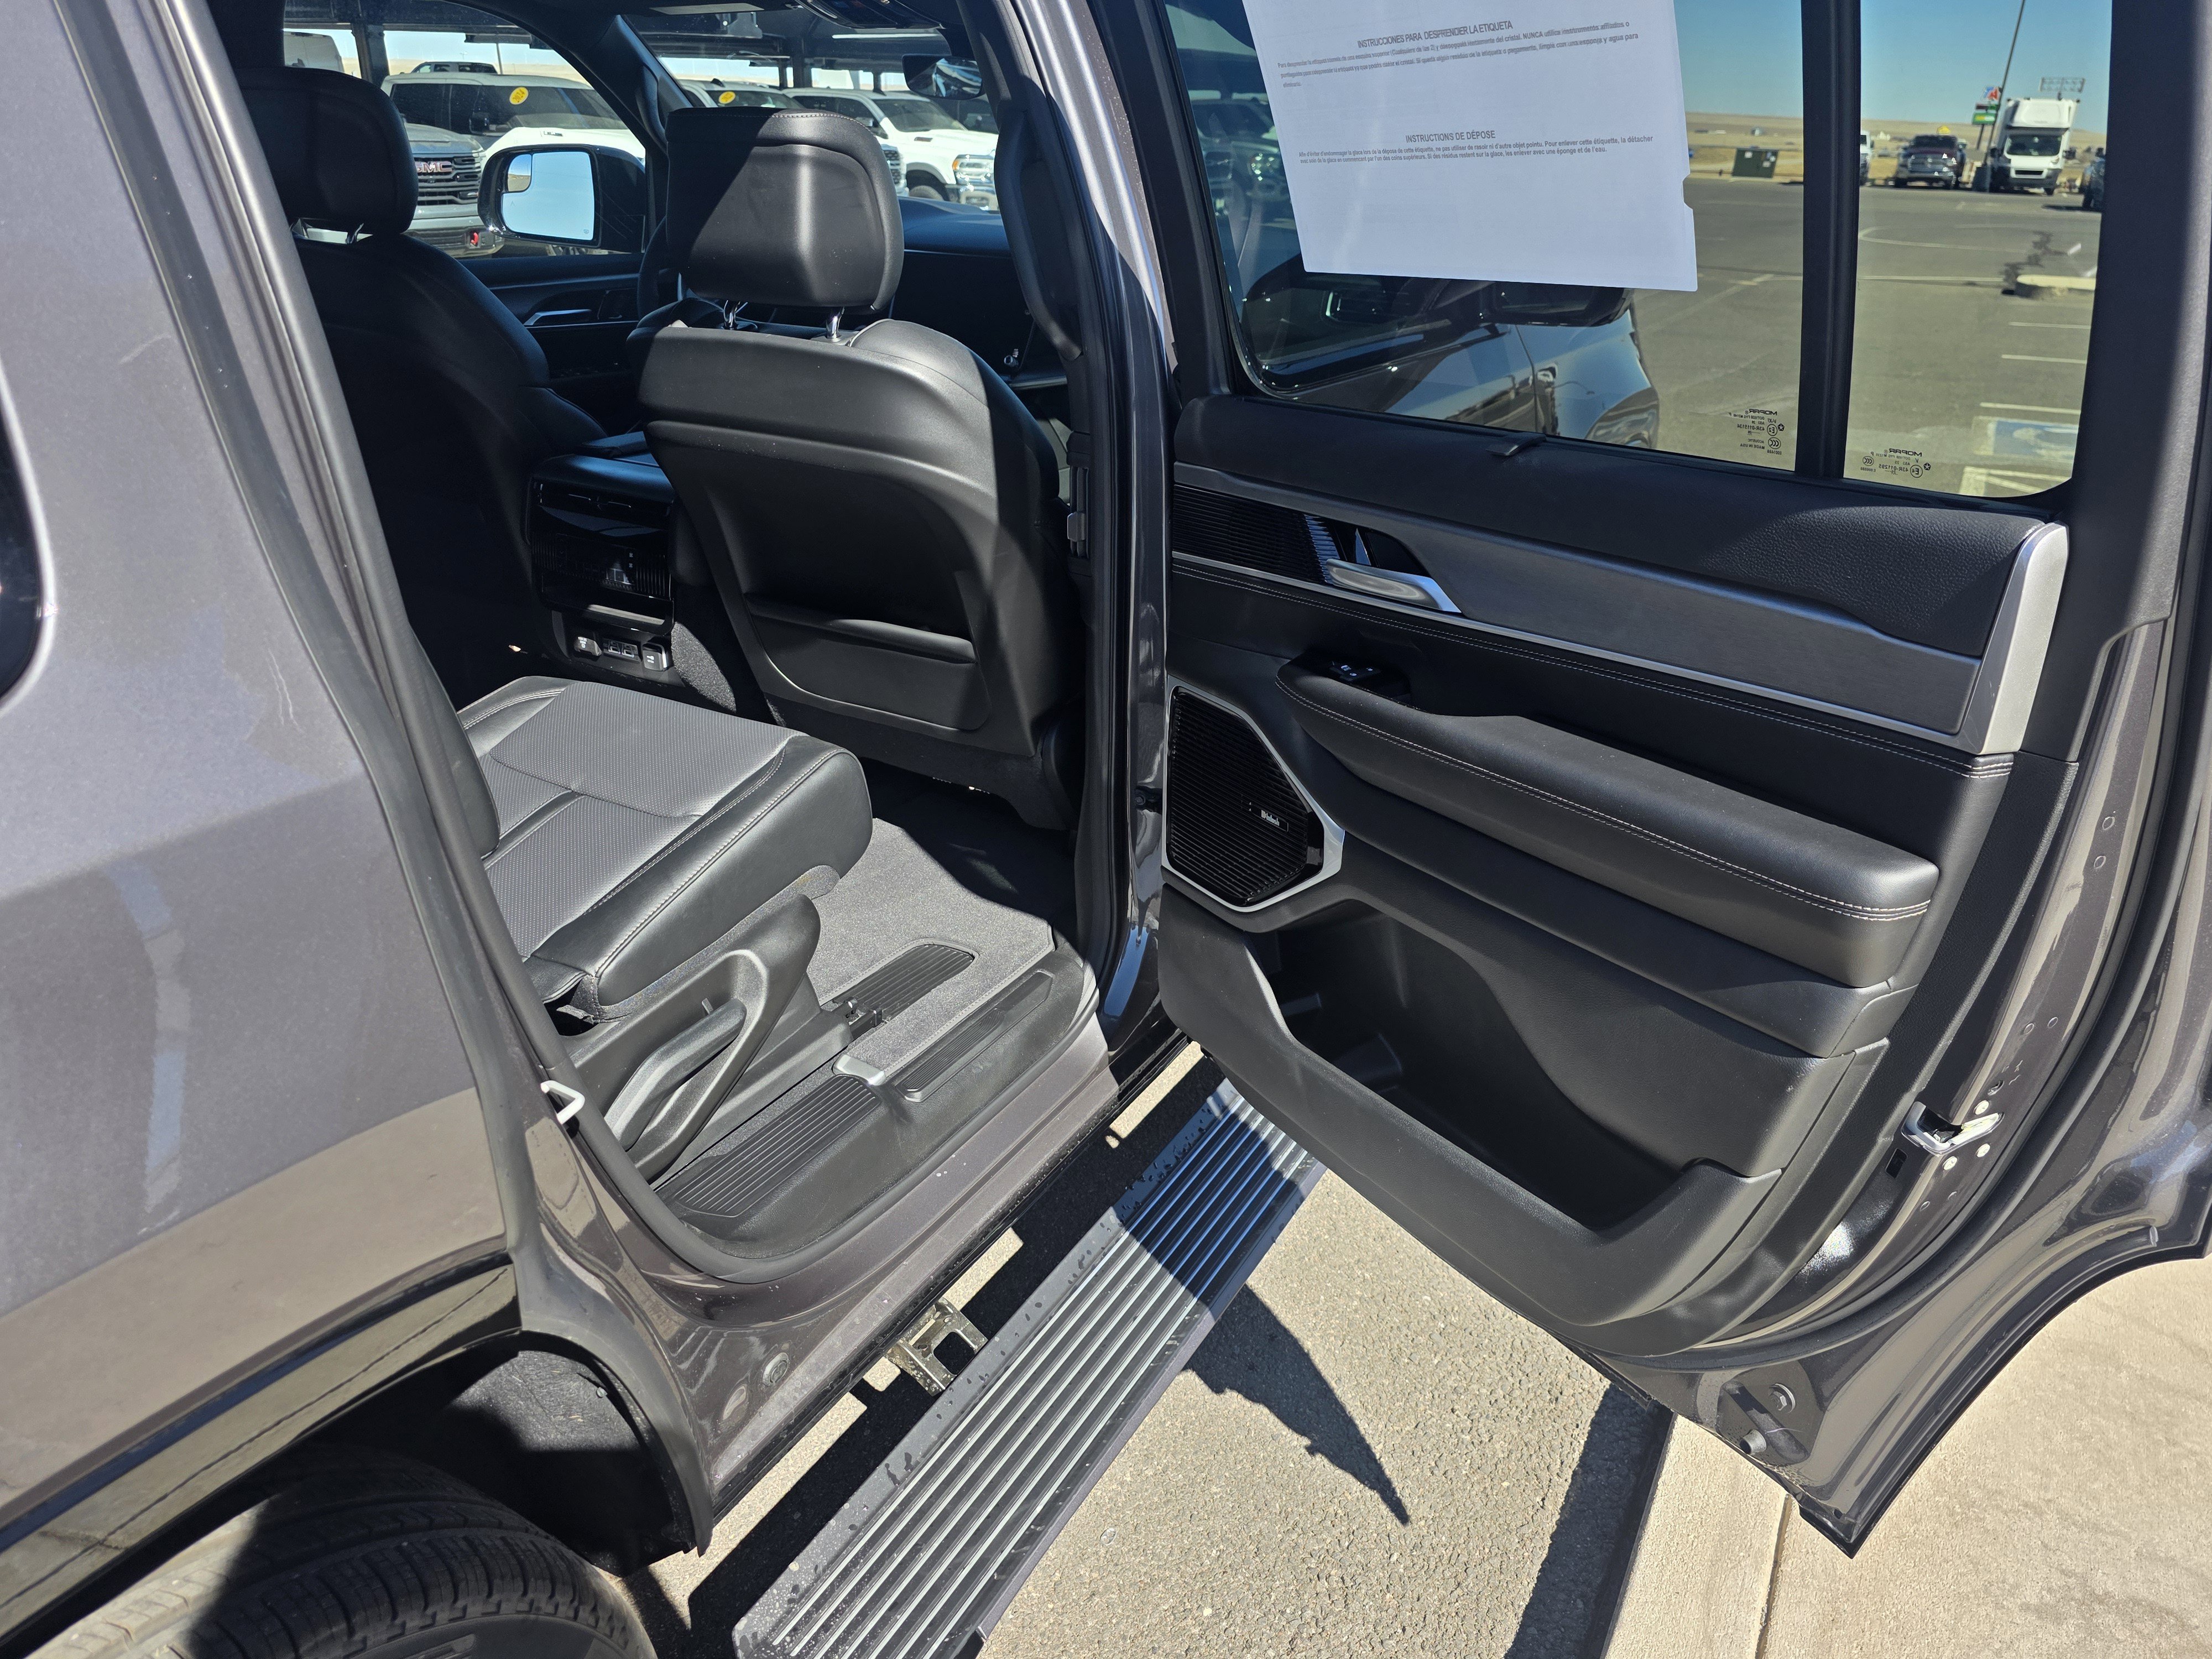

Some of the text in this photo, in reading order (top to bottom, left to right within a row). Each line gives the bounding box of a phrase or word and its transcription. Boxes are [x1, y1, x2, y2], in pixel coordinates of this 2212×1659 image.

[1358, 20, 1513, 48] INSTRUCCIONES PARA DESPRENDER LA ETIQUETA
[1523, 31, 1543, 39] NUNCA
[1405, 130, 1496, 143] INSTRUCTIONS DE DÉPOSE
[1512, 142, 1526, 150] objet
[1526, 141, 1544, 149] pointu.
[1593, 137, 1620, 146] étiquette,
[1403, 153, 1427, 161] supérieurs.
[1490, 150, 1505, 158] glace,
[1557, 147, 1576, 155] éponge
